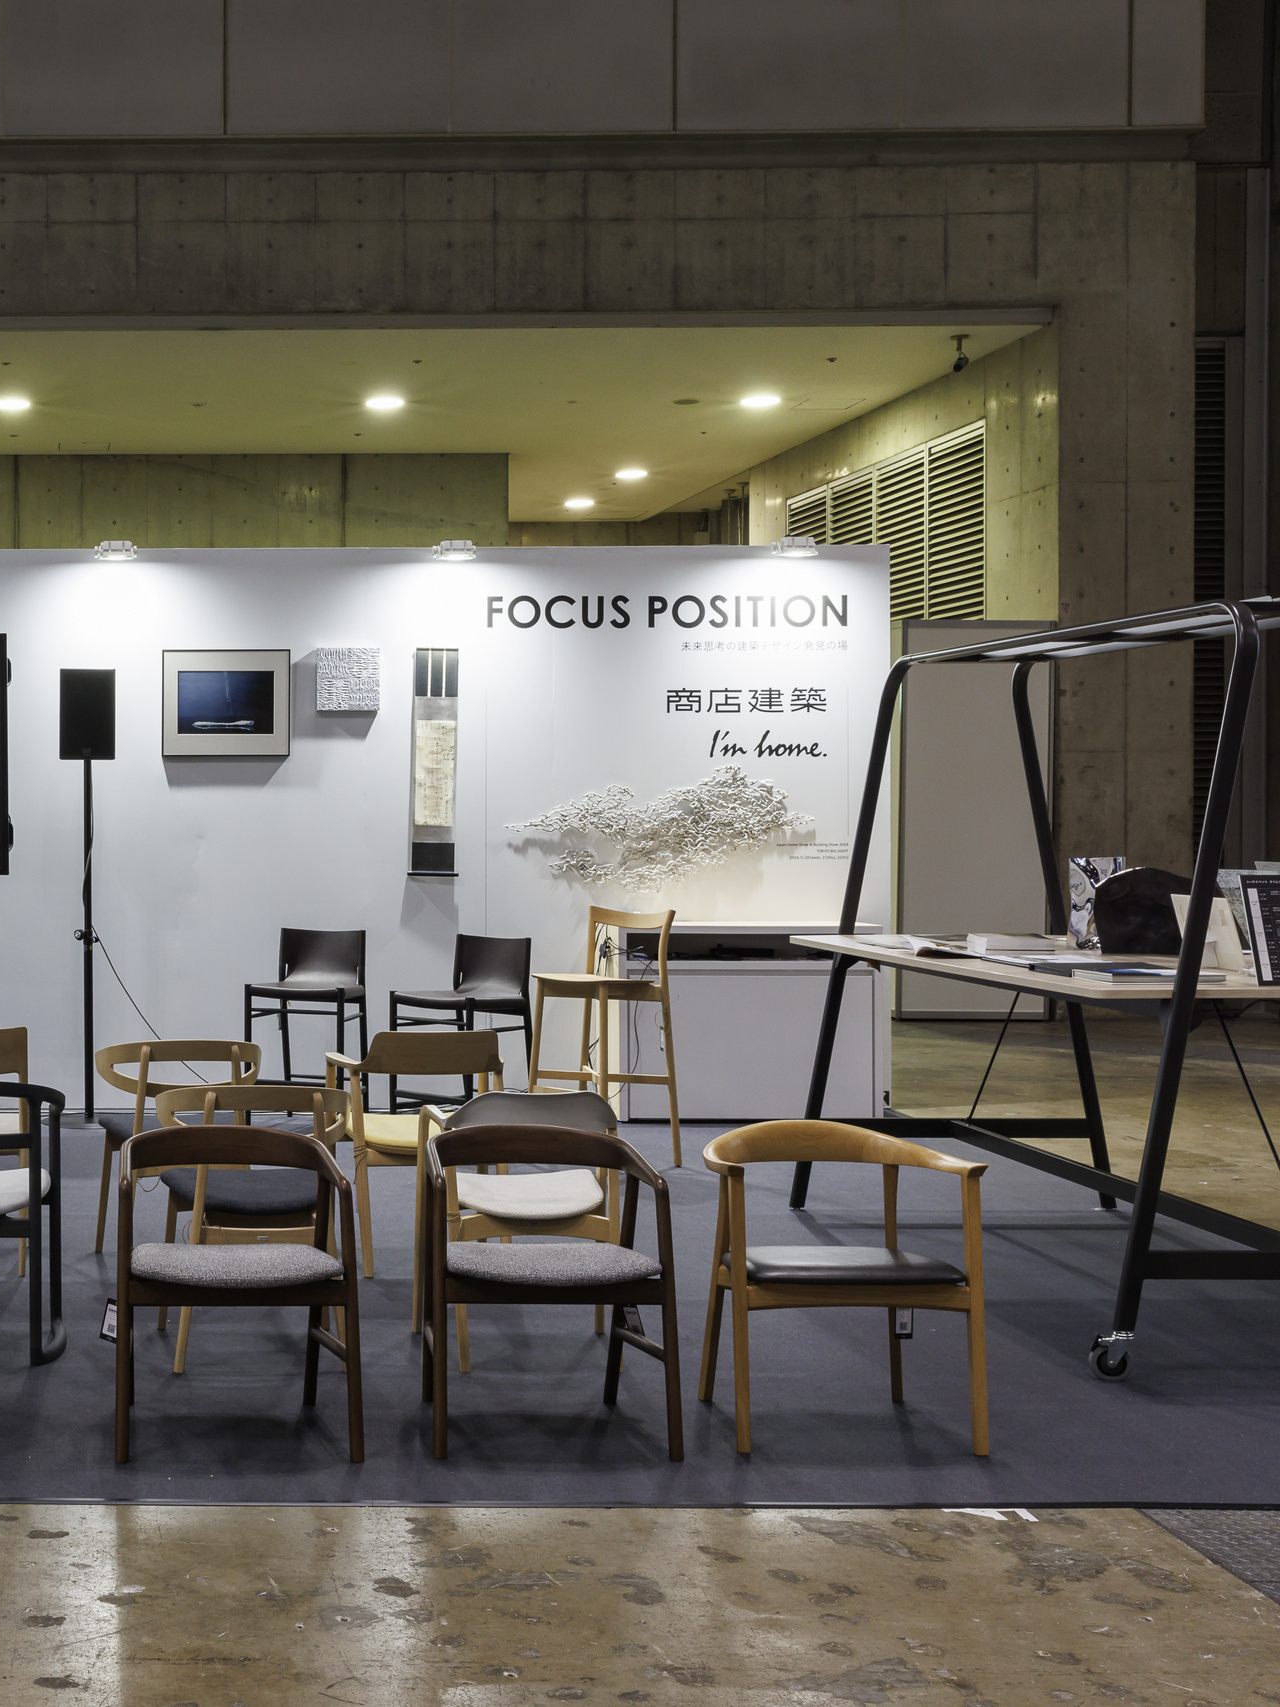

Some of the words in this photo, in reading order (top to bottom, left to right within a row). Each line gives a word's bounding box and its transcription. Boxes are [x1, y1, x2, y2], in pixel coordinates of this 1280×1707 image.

[486, 594, 631, 629] FOCUS
[647, 594, 849, 629] POSITION
[681, 640, 848, 651] 未来思考の建築デザイン発見の場
[666, 686, 828, 714] 商店建築
[709, 729, 748, 759] I'm
[753, 729, 828, 759] home.
